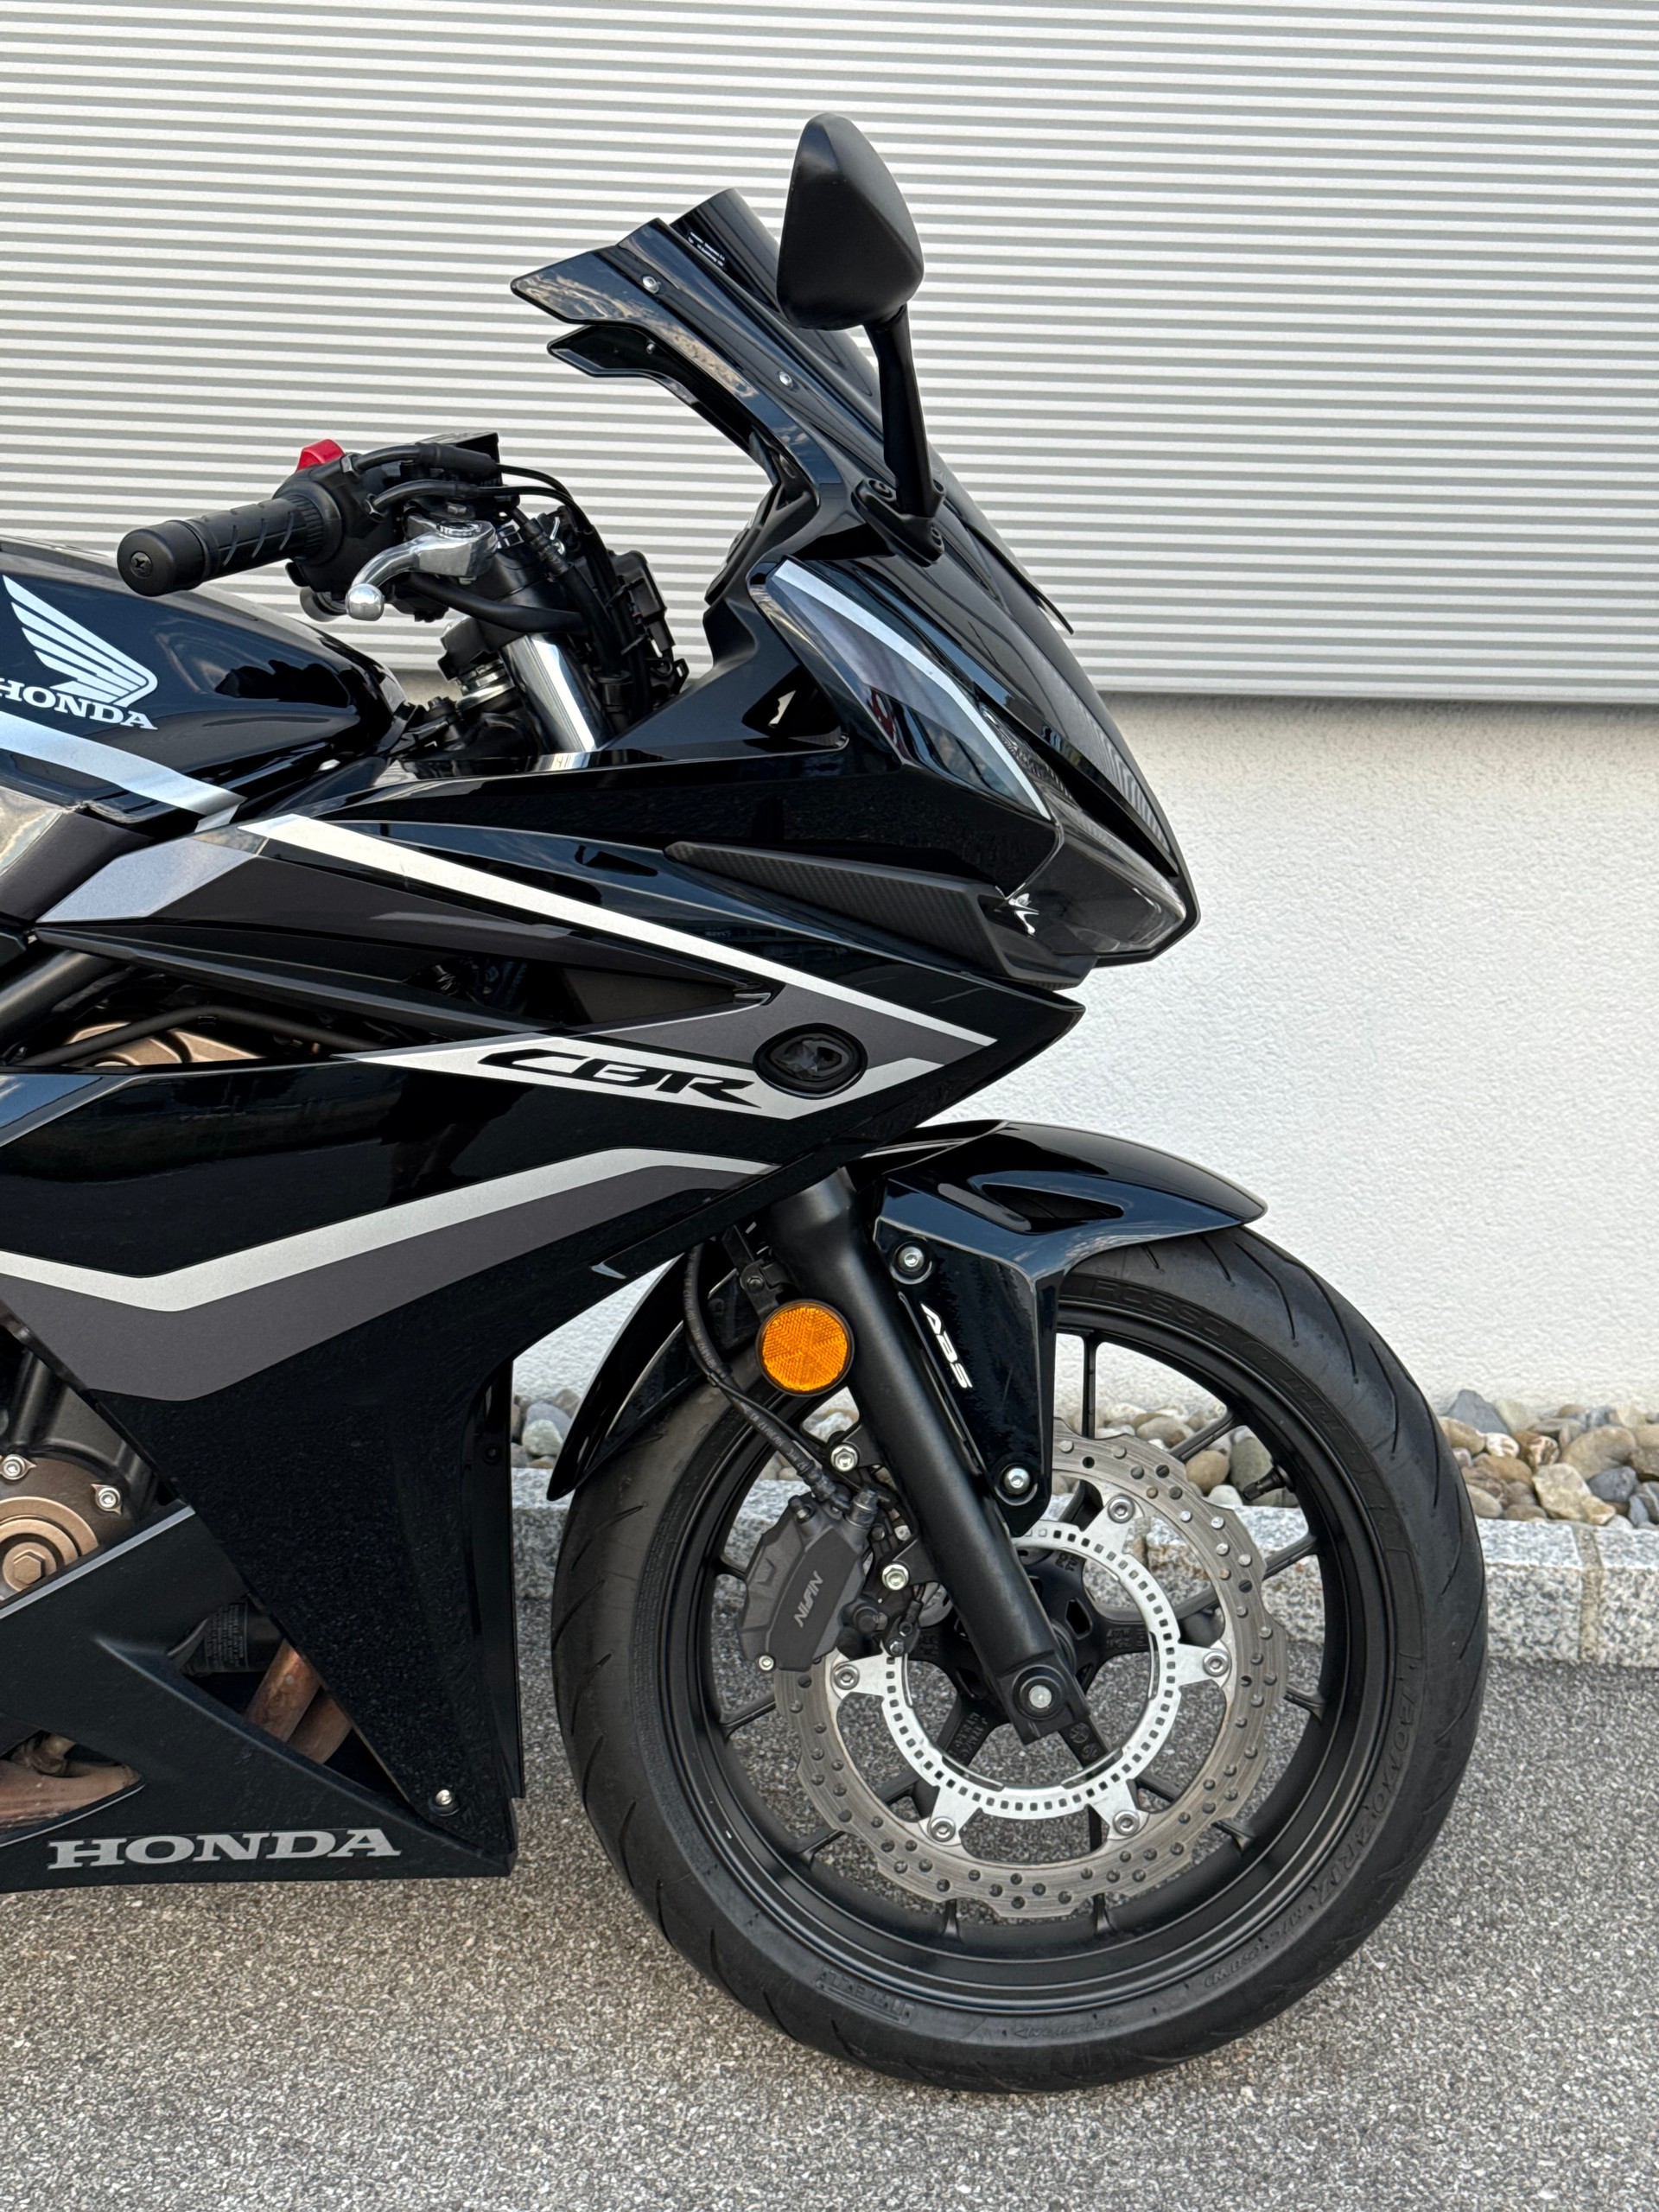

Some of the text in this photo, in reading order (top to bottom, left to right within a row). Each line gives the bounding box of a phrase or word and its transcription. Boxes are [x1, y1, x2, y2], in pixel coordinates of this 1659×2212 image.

[0, 677, 159, 730] HONDA
[478, 1047, 762, 1109] CBR
[920, 1303, 973, 1389] ABS
[47, 1828, 402, 1870] HONDA
